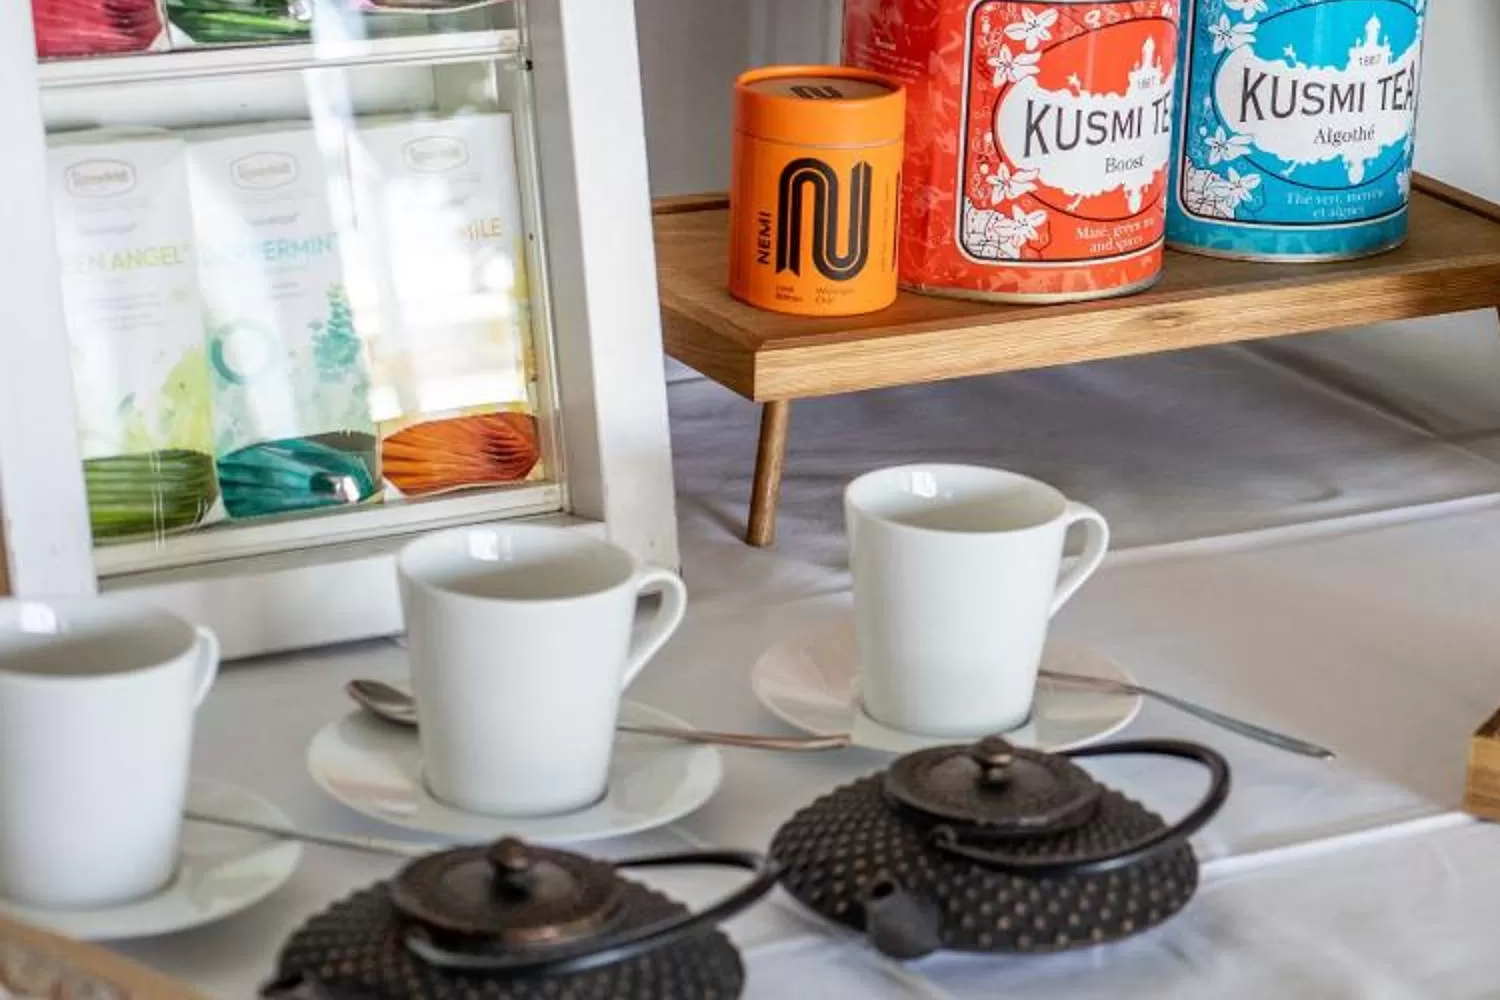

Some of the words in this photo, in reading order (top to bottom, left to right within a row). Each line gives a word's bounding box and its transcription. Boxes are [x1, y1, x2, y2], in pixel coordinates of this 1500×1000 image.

[1239, 67, 1366, 122] KUSMI
[1377, 60, 1415, 111] TEA
[1024, 99, 1143, 157] KUSMI
[1152, 90, 1170, 135] TE
[1105, 155, 1144, 174] Boost
[757, 210, 772, 265] NEMI
